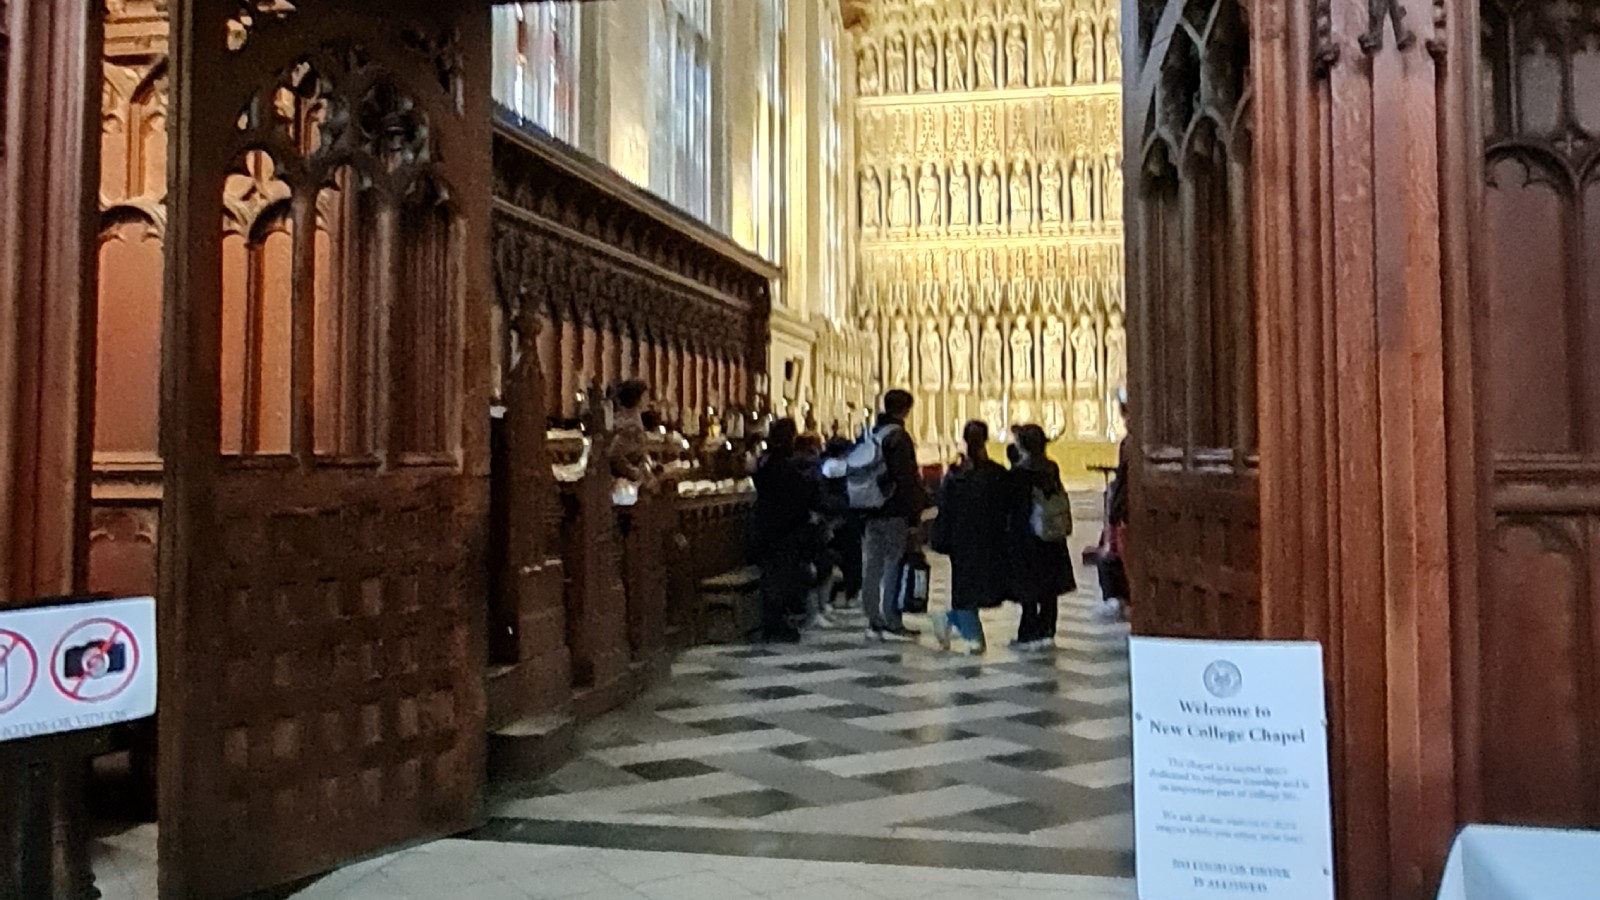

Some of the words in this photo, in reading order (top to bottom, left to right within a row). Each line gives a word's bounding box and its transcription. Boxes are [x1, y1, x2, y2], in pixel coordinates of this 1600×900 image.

[1179, 699, 1249, 718] Welcome
[1255, 705, 1271, 718] to
[1150, 719, 1182, 736] New
[1187, 724, 1245, 743] College
[1249, 726, 1305, 746] Chapel
